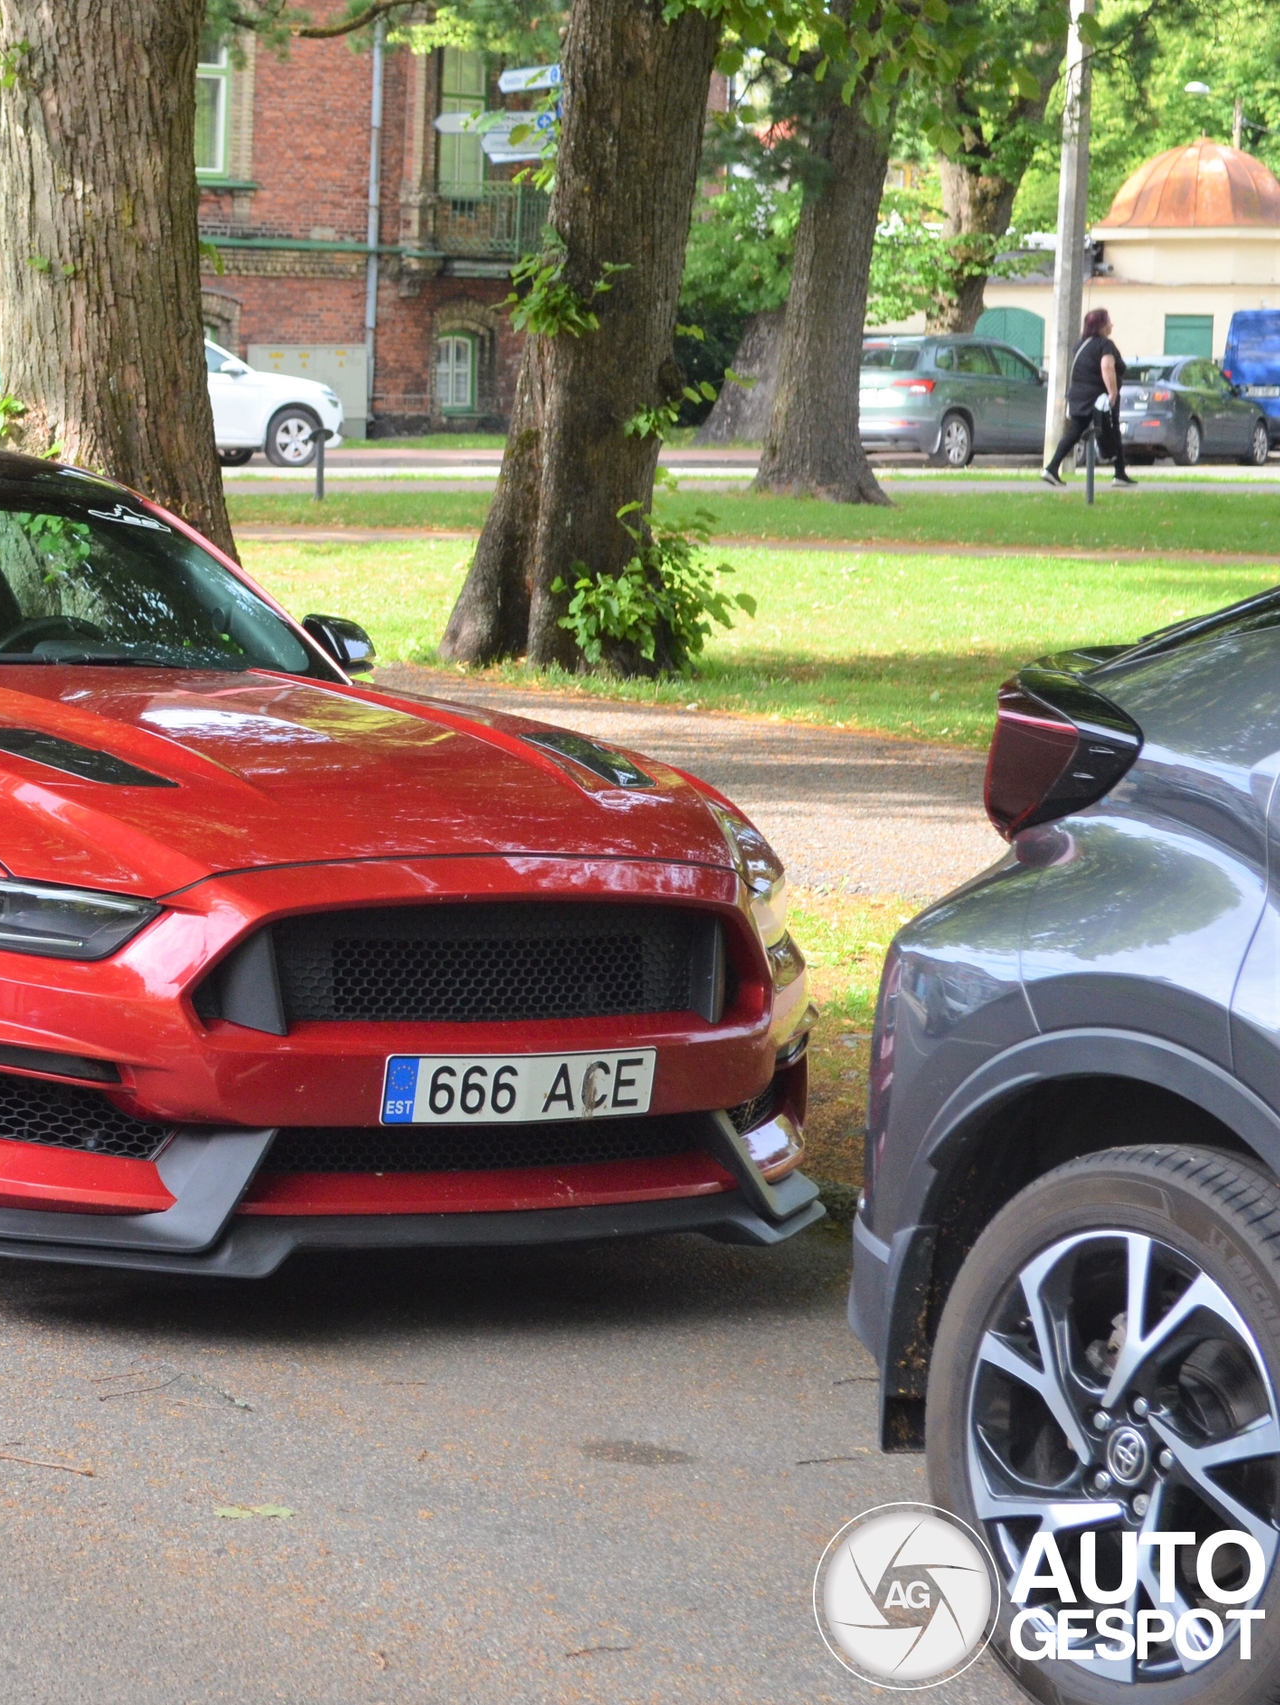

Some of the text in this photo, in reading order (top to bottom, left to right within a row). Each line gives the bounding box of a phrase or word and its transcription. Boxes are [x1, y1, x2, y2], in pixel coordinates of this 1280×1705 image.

[428, 1058, 644, 1115] 666 ACE
[385, 1100, 413, 1114] EST
